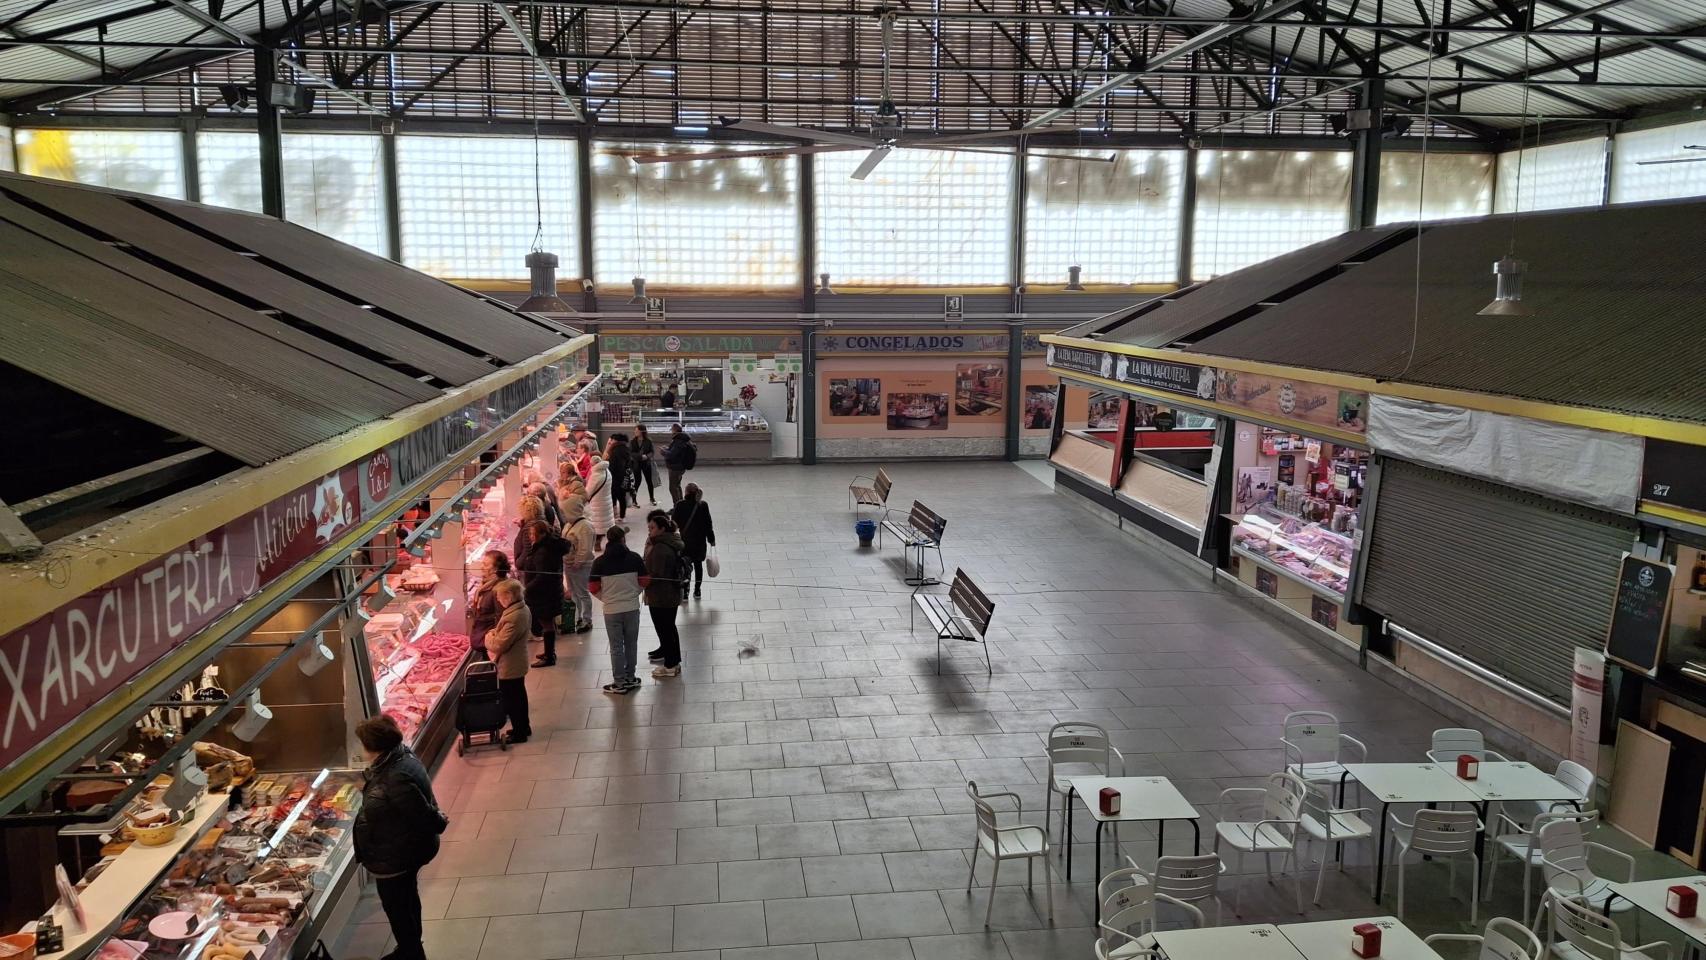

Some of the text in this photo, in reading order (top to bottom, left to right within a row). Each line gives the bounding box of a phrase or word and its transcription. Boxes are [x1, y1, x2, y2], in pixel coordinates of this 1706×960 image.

[603, 336, 665, 350] PESCA
[679, 336, 753, 350] SALADA
[845, 335, 964, 349] CONGELADOS
[1132, 360, 1140, 374] LA
[1153, 363, 1191, 384] XARCUTERIA
[1653, 483, 1671, 497] 27
[0, 492, 310, 748] XARCUTERIA Mireia
[1568, 918, 1587, 931] TURIA
